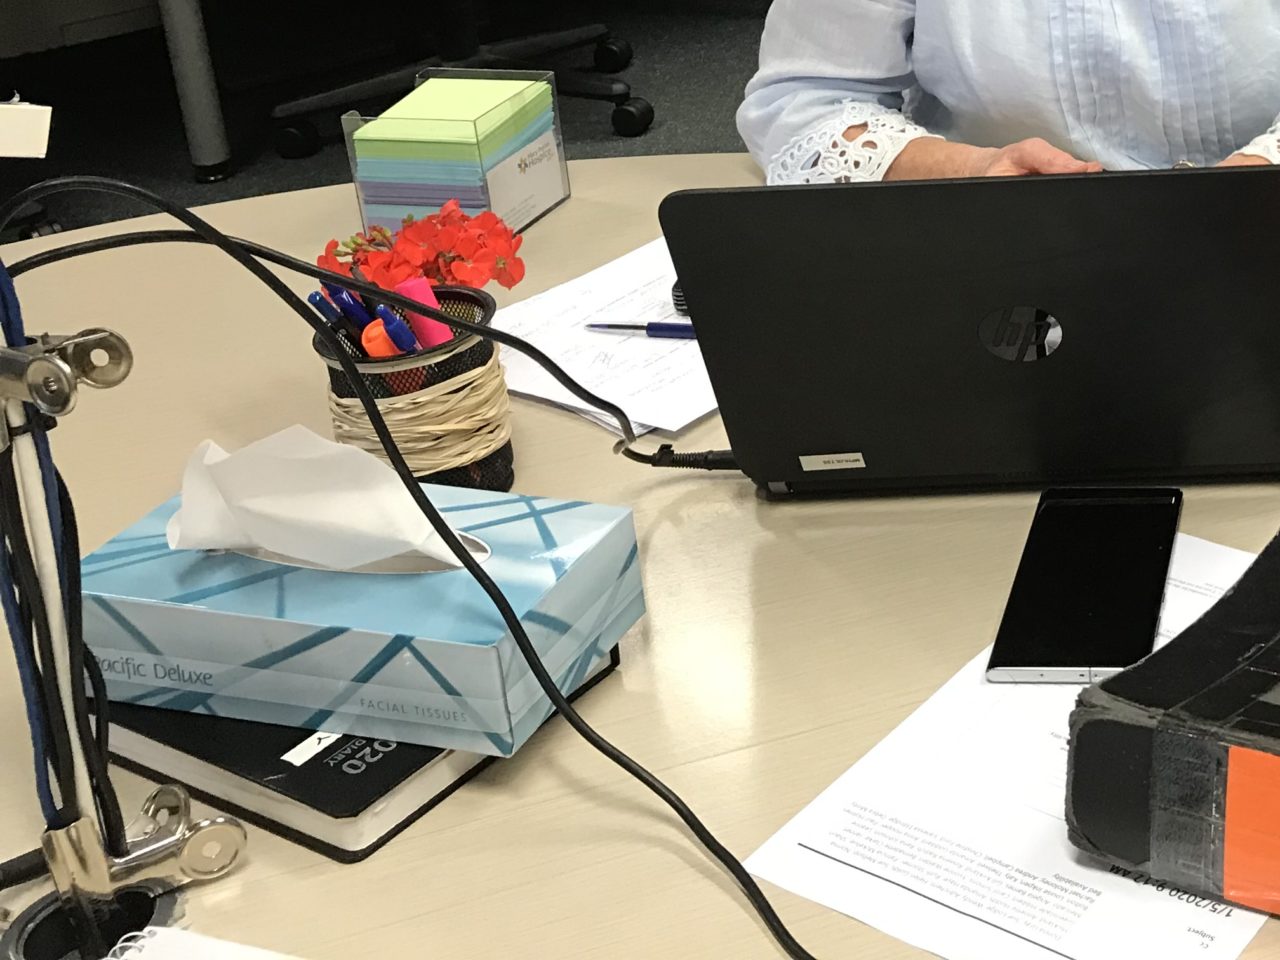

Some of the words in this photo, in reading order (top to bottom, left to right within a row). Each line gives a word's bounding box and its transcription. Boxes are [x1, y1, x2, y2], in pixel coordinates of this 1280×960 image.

[98, 656, 147, 680] acific
[153, 663, 213, 686] Deluxe
[360, 698, 408, 714] FACIAL
[414, 705, 467, 722] TISSUES
[328, 738, 366, 767] DIARY
[342, 739, 397, 774] 020
[1086, 886, 1102, 897] Bed
[1132, 871, 1167, 893] 9:12
[1167, 885, 1233, 918] 1/5/2020
[1185, 925, 1216, 942] Subject
